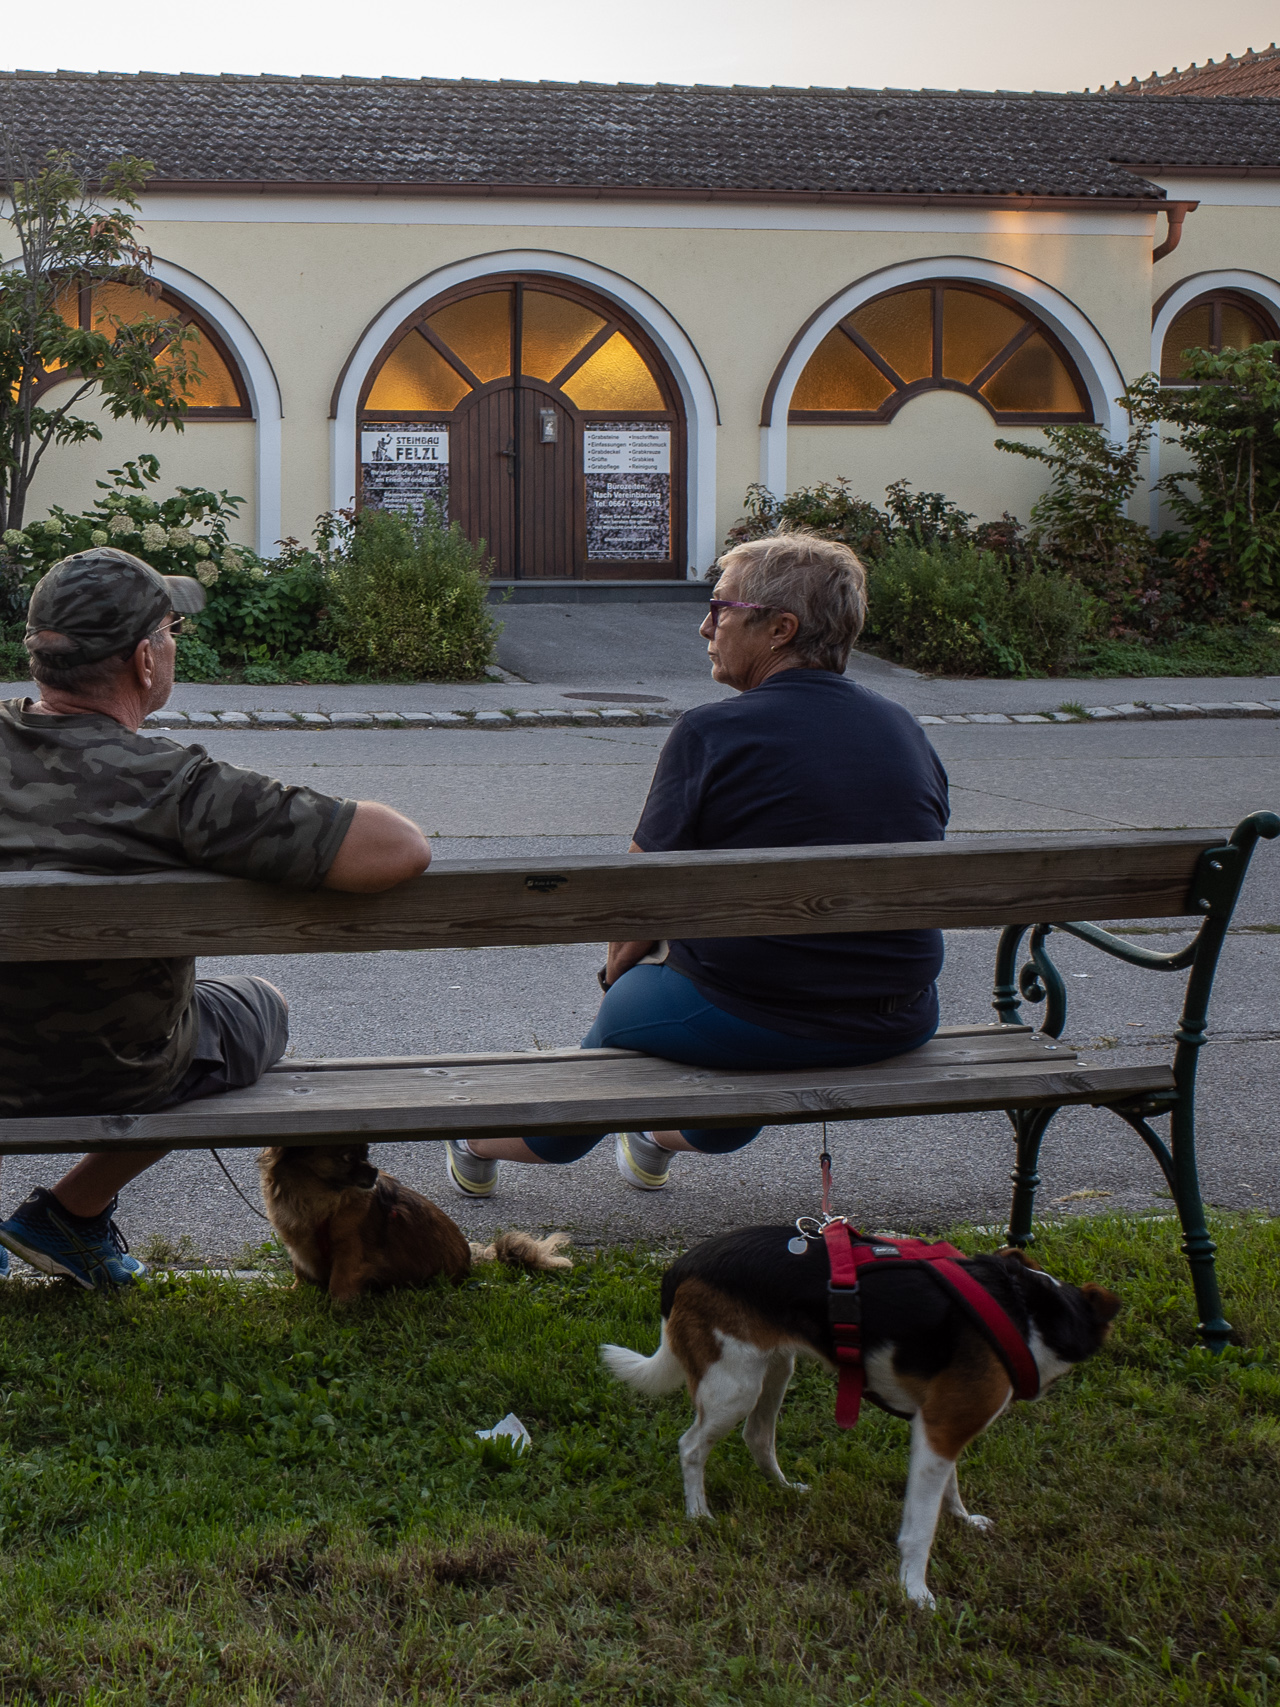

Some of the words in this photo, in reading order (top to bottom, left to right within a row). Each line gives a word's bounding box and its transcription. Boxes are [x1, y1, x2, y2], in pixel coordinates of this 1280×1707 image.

[396, 436, 440, 445] STEINBAU
[396, 447, 439, 461] FELZL
[607, 482, 647, 490] Bürozeiten:
[613, 491, 661, 499] Vereinbarung
